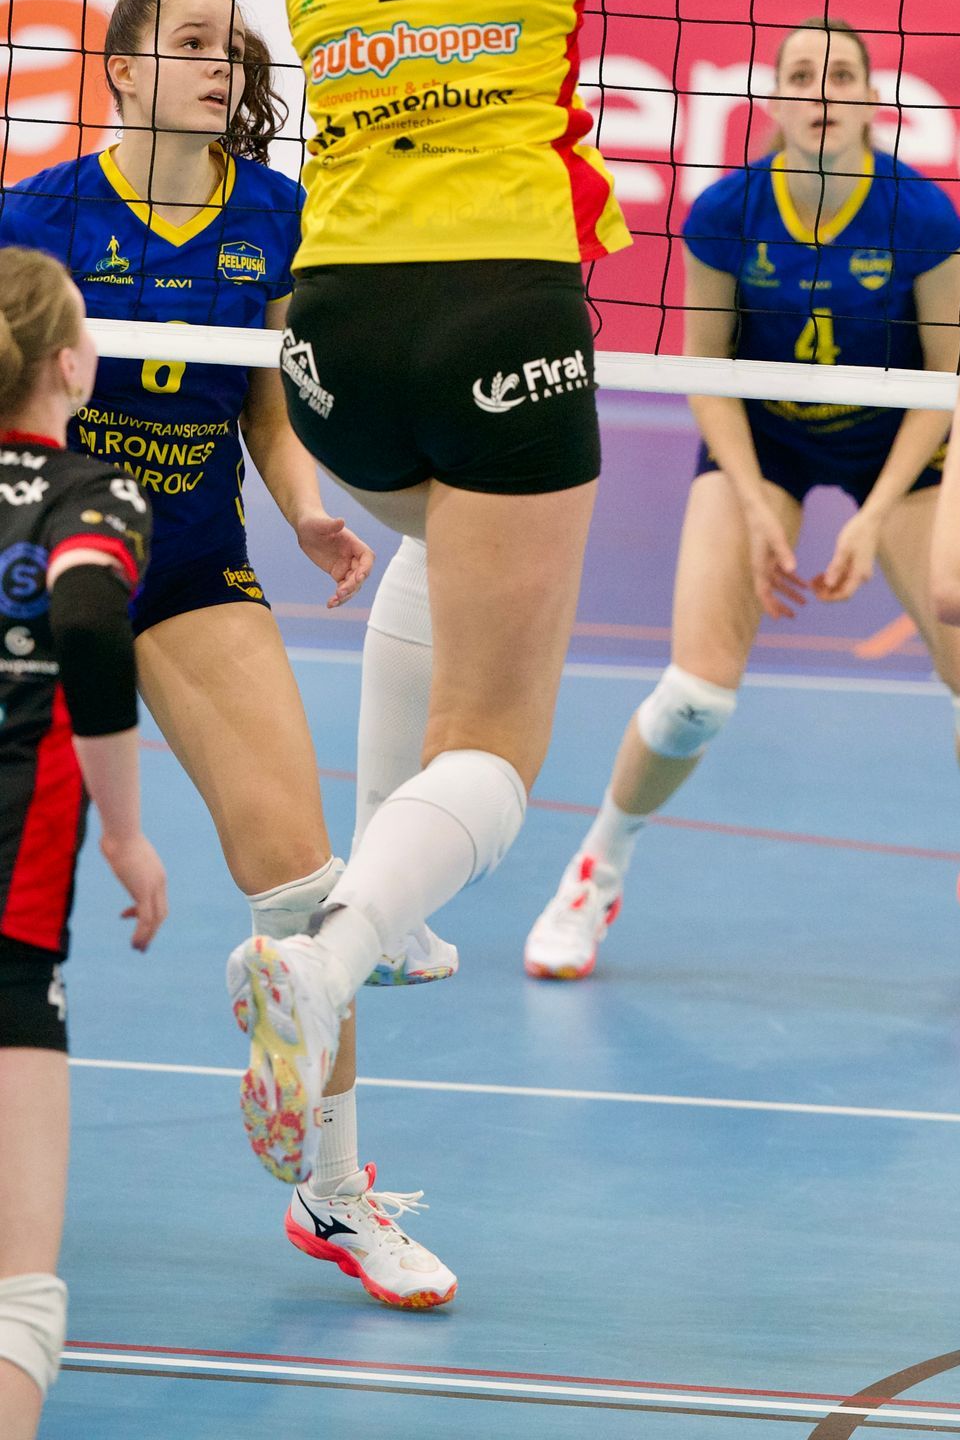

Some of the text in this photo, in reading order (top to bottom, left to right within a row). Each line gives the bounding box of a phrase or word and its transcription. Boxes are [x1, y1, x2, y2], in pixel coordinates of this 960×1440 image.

[311, 23, 518, 79] autohopper
[154, 278, 193, 289] XAVI
[218, 253, 264, 273] PEELPUSH
[795, 308, 842, 365] 4
[522, 349, 587, 392] Firat
[79, 425, 216, 467] M.RONNES
